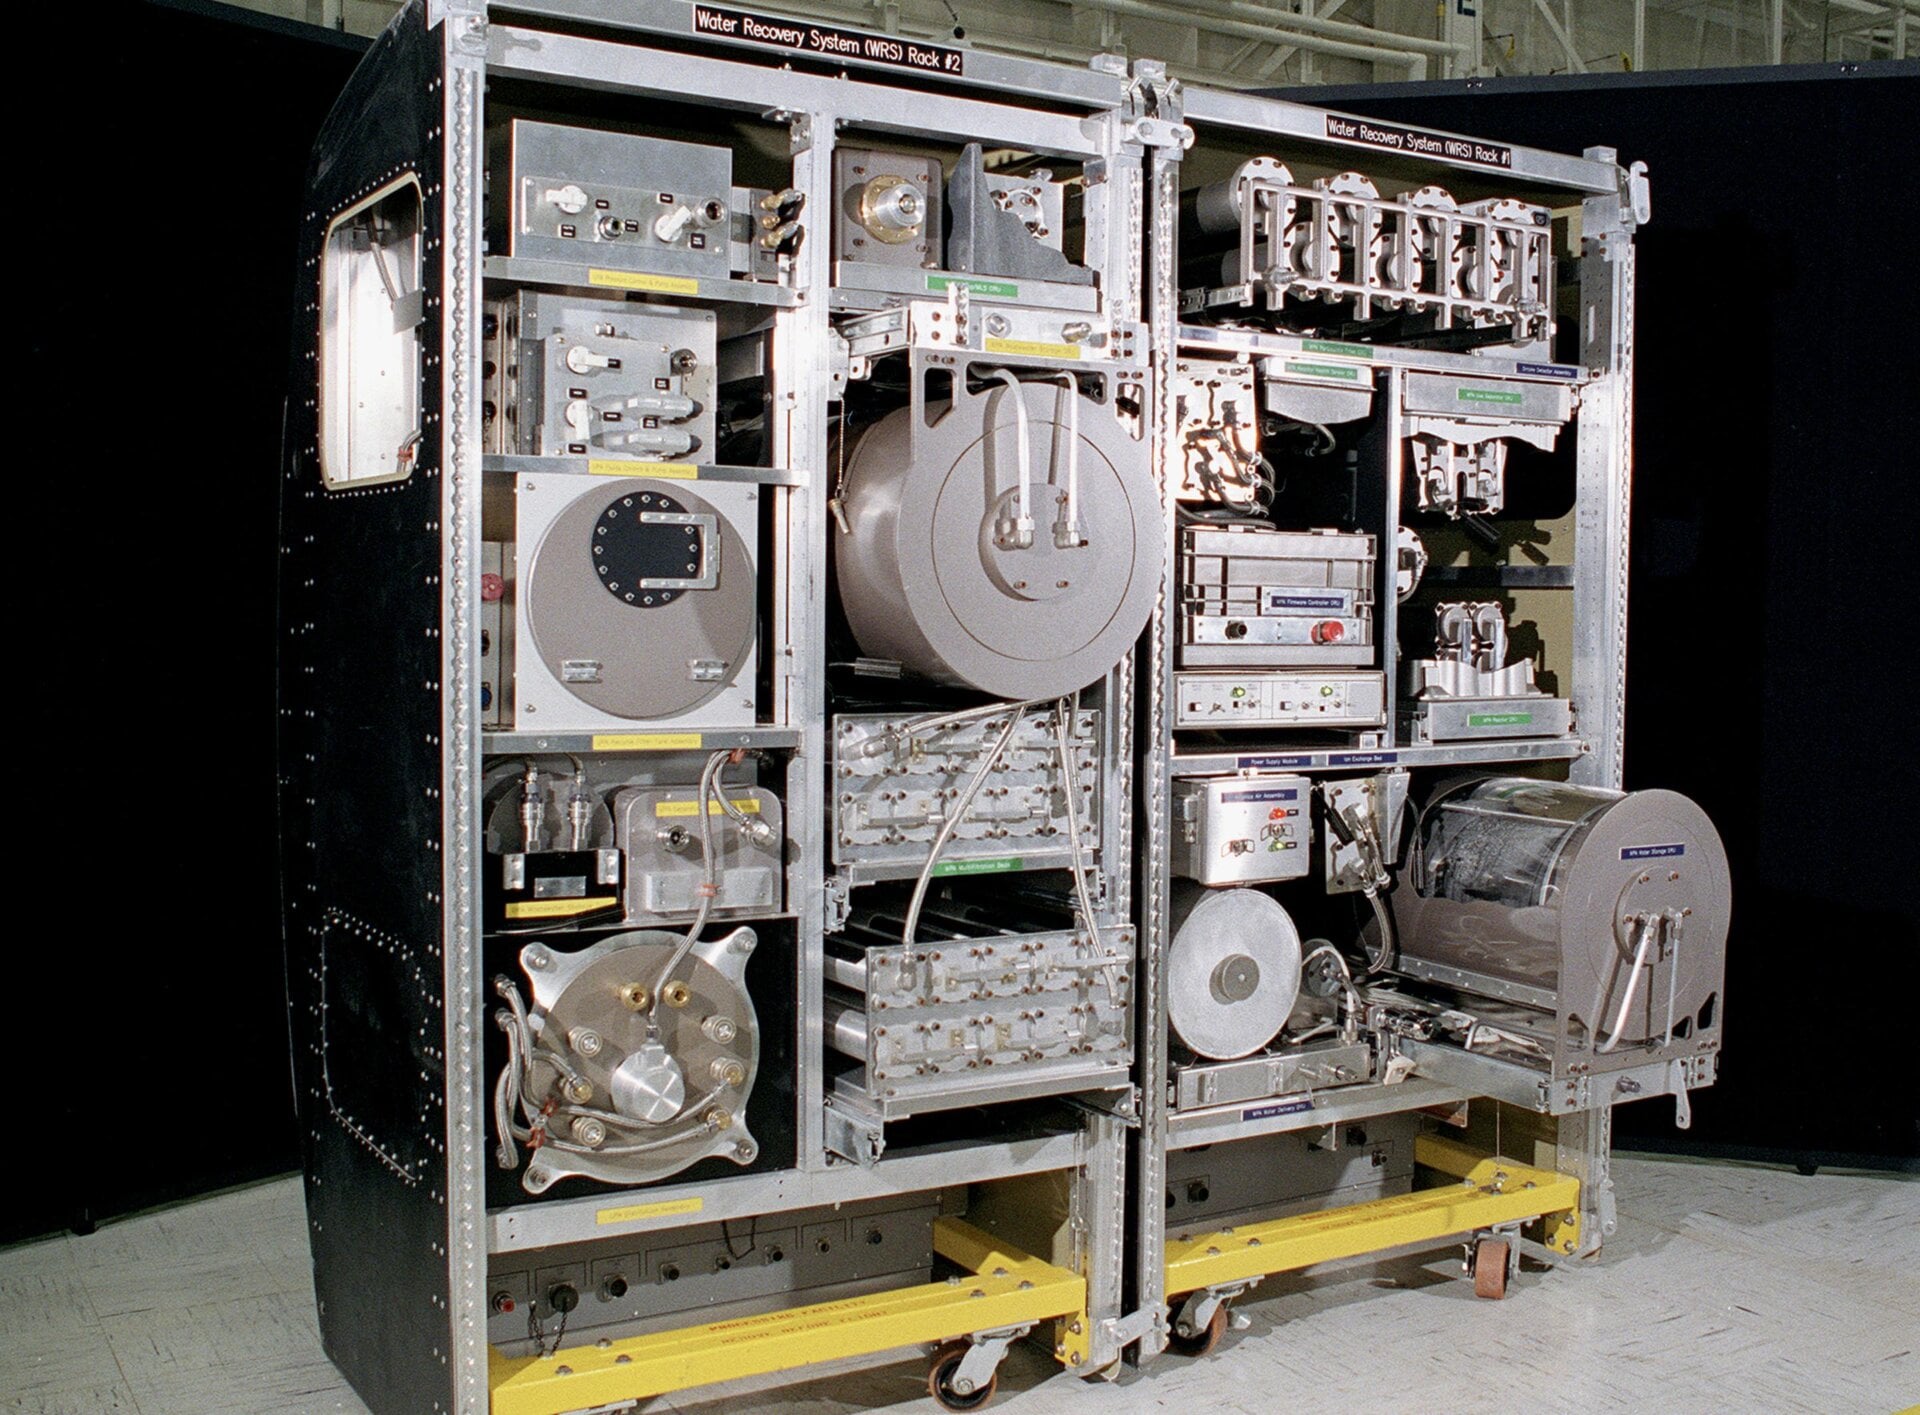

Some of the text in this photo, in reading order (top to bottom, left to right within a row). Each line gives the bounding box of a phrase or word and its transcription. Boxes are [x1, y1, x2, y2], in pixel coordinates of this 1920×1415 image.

[697, 10, 961, 72] Water Recovery System (WRS) Rack #2
[1328, 119, 1511, 167] Water Recovery System (WRS) Rack #1
